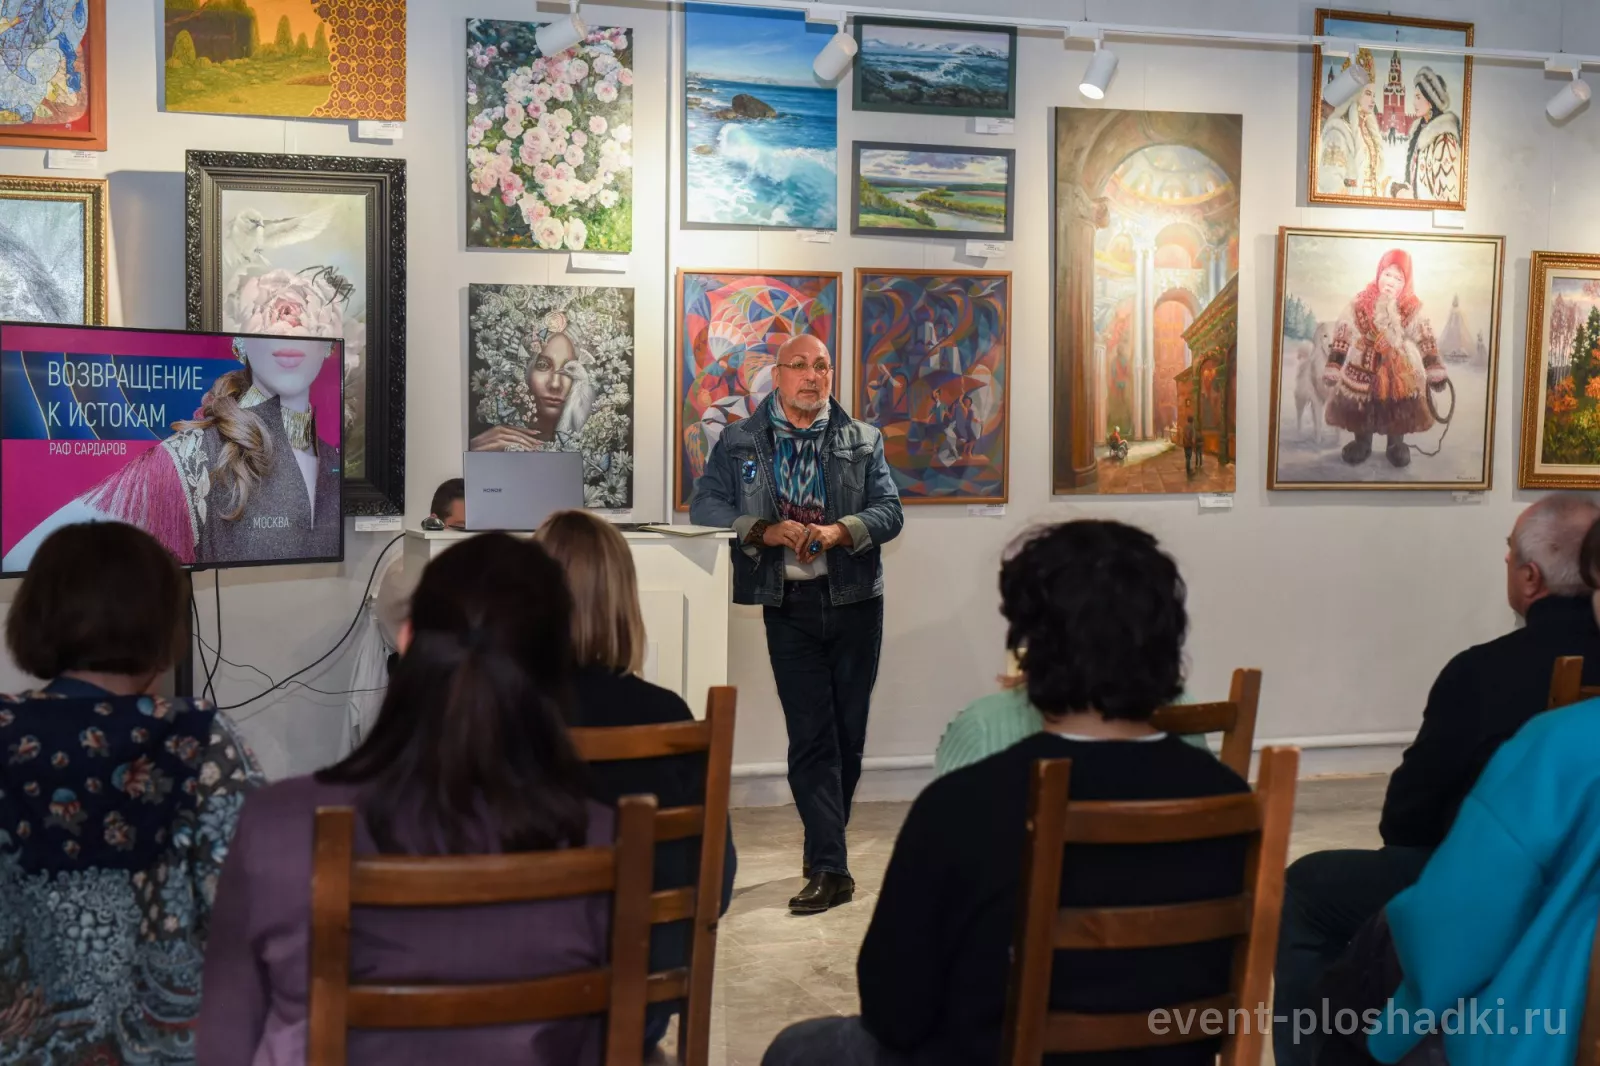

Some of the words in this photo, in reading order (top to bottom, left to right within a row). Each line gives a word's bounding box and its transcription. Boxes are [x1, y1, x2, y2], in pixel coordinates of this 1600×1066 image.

[48, 361, 203, 392] ВОЗВРАЩЕНИЕ
[48, 401, 62, 427] К
[69, 402, 166, 428] ИСТОКАМ
[49, 441, 72, 455] РАФ
[74, 442, 127, 456] САРДАРОВ
[253, 516, 290, 529] МОСКВА
